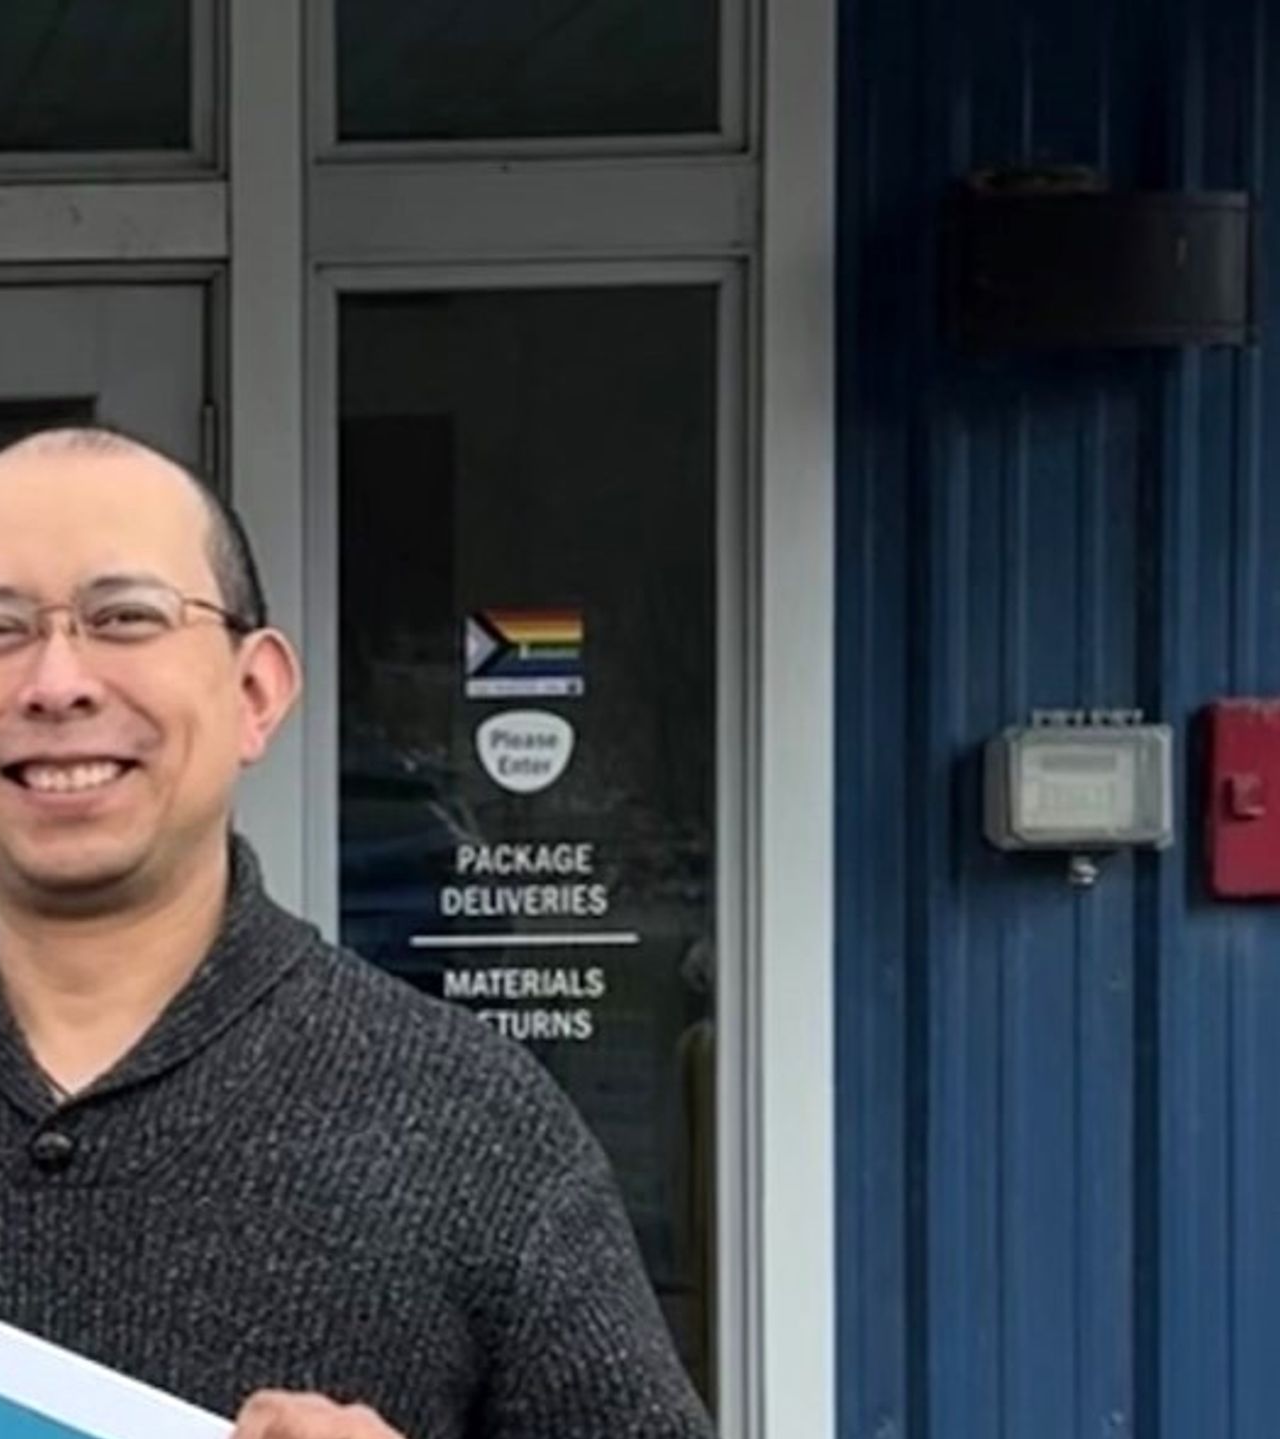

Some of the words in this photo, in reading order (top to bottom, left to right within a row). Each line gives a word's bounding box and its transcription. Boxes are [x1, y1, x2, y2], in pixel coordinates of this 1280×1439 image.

[491, 729, 558, 749] Please
[498, 756, 551, 776] Enter
[457, 843, 593, 873] PACKAGE
[441, 884, 608, 916] DELIVERIES
[444, 967, 605, 998] MATERIALS
[478, 1009, 592, 1039] TURNS
